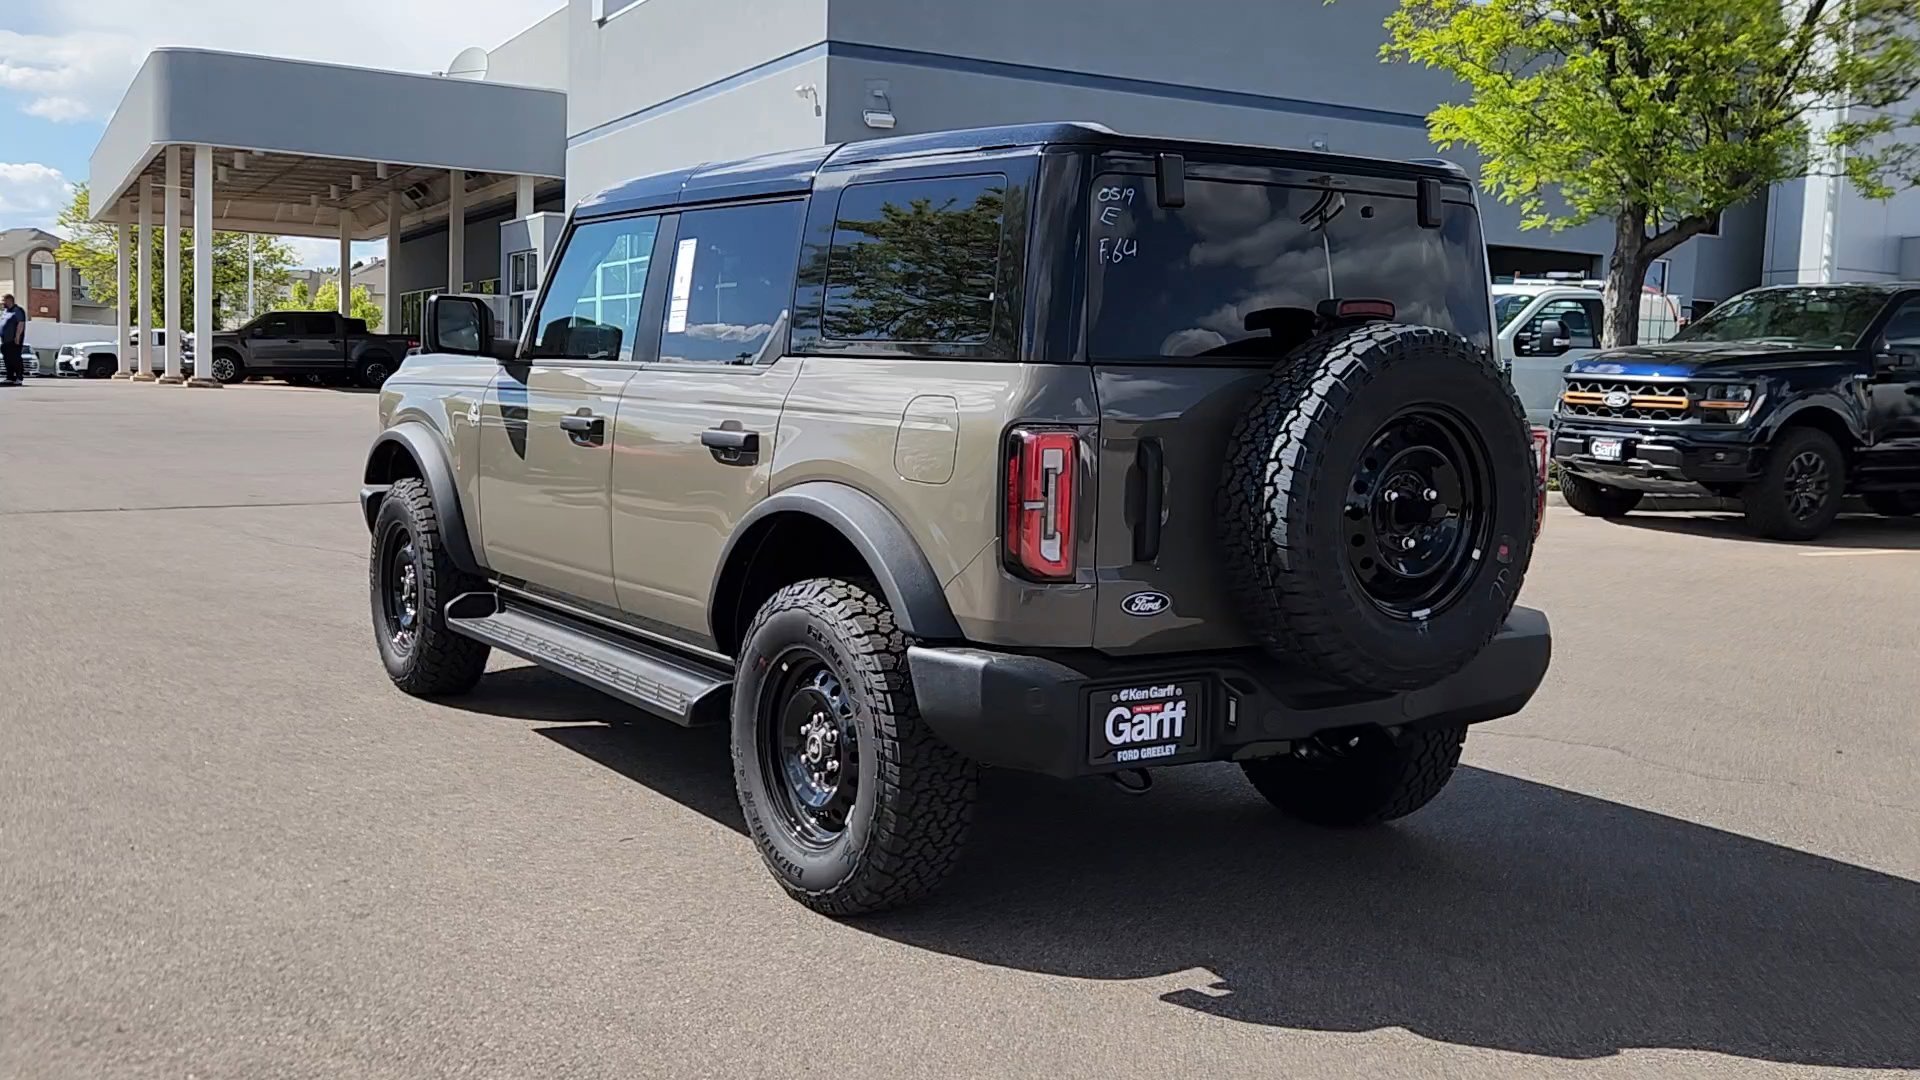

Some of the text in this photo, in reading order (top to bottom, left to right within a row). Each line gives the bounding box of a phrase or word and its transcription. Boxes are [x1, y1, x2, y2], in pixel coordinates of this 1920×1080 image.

[1097, 186, 1135, 206] 0519
[1100, 206, 1122, 226] E
[1591, 440, 1622, 457] Garff
[1128, 684, 1176, 701] Ken Garff
[1105, 700, 1187, 745] Garff
[1117, 744, 1177, 762] FORD GREELEY
